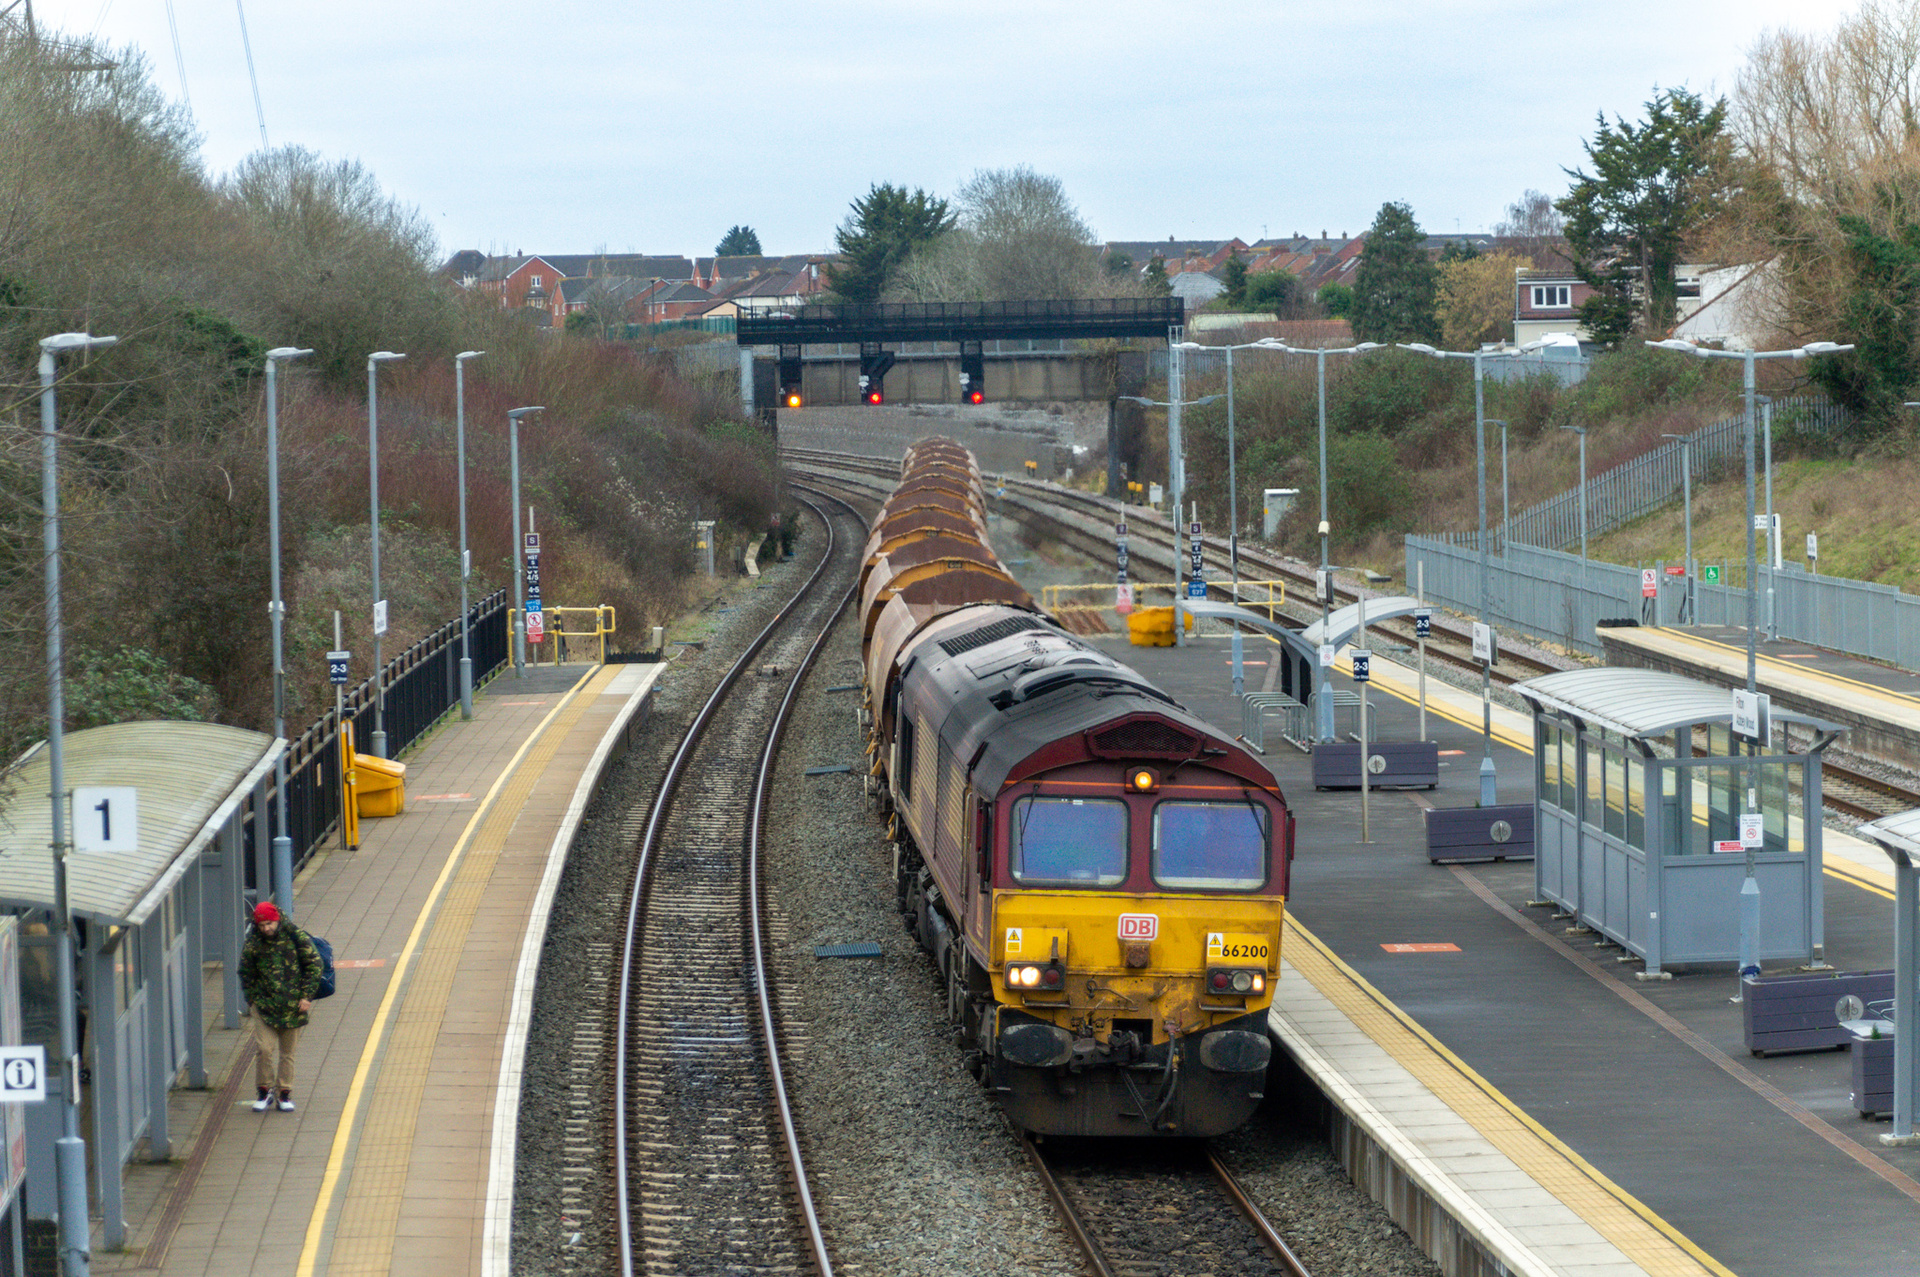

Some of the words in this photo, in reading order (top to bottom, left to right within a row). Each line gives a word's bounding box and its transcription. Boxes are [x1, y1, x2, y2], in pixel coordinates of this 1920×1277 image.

[1416, 619, 1430, 628] 2-3
[330, 663, 347, 673] 2-3
[1354, 661, 1369, 671] 2-3
[94, 798, 111, 841] 1
[1124, 919, 1151, 935] DB
[1222, 944, 1268, 958] 66200
